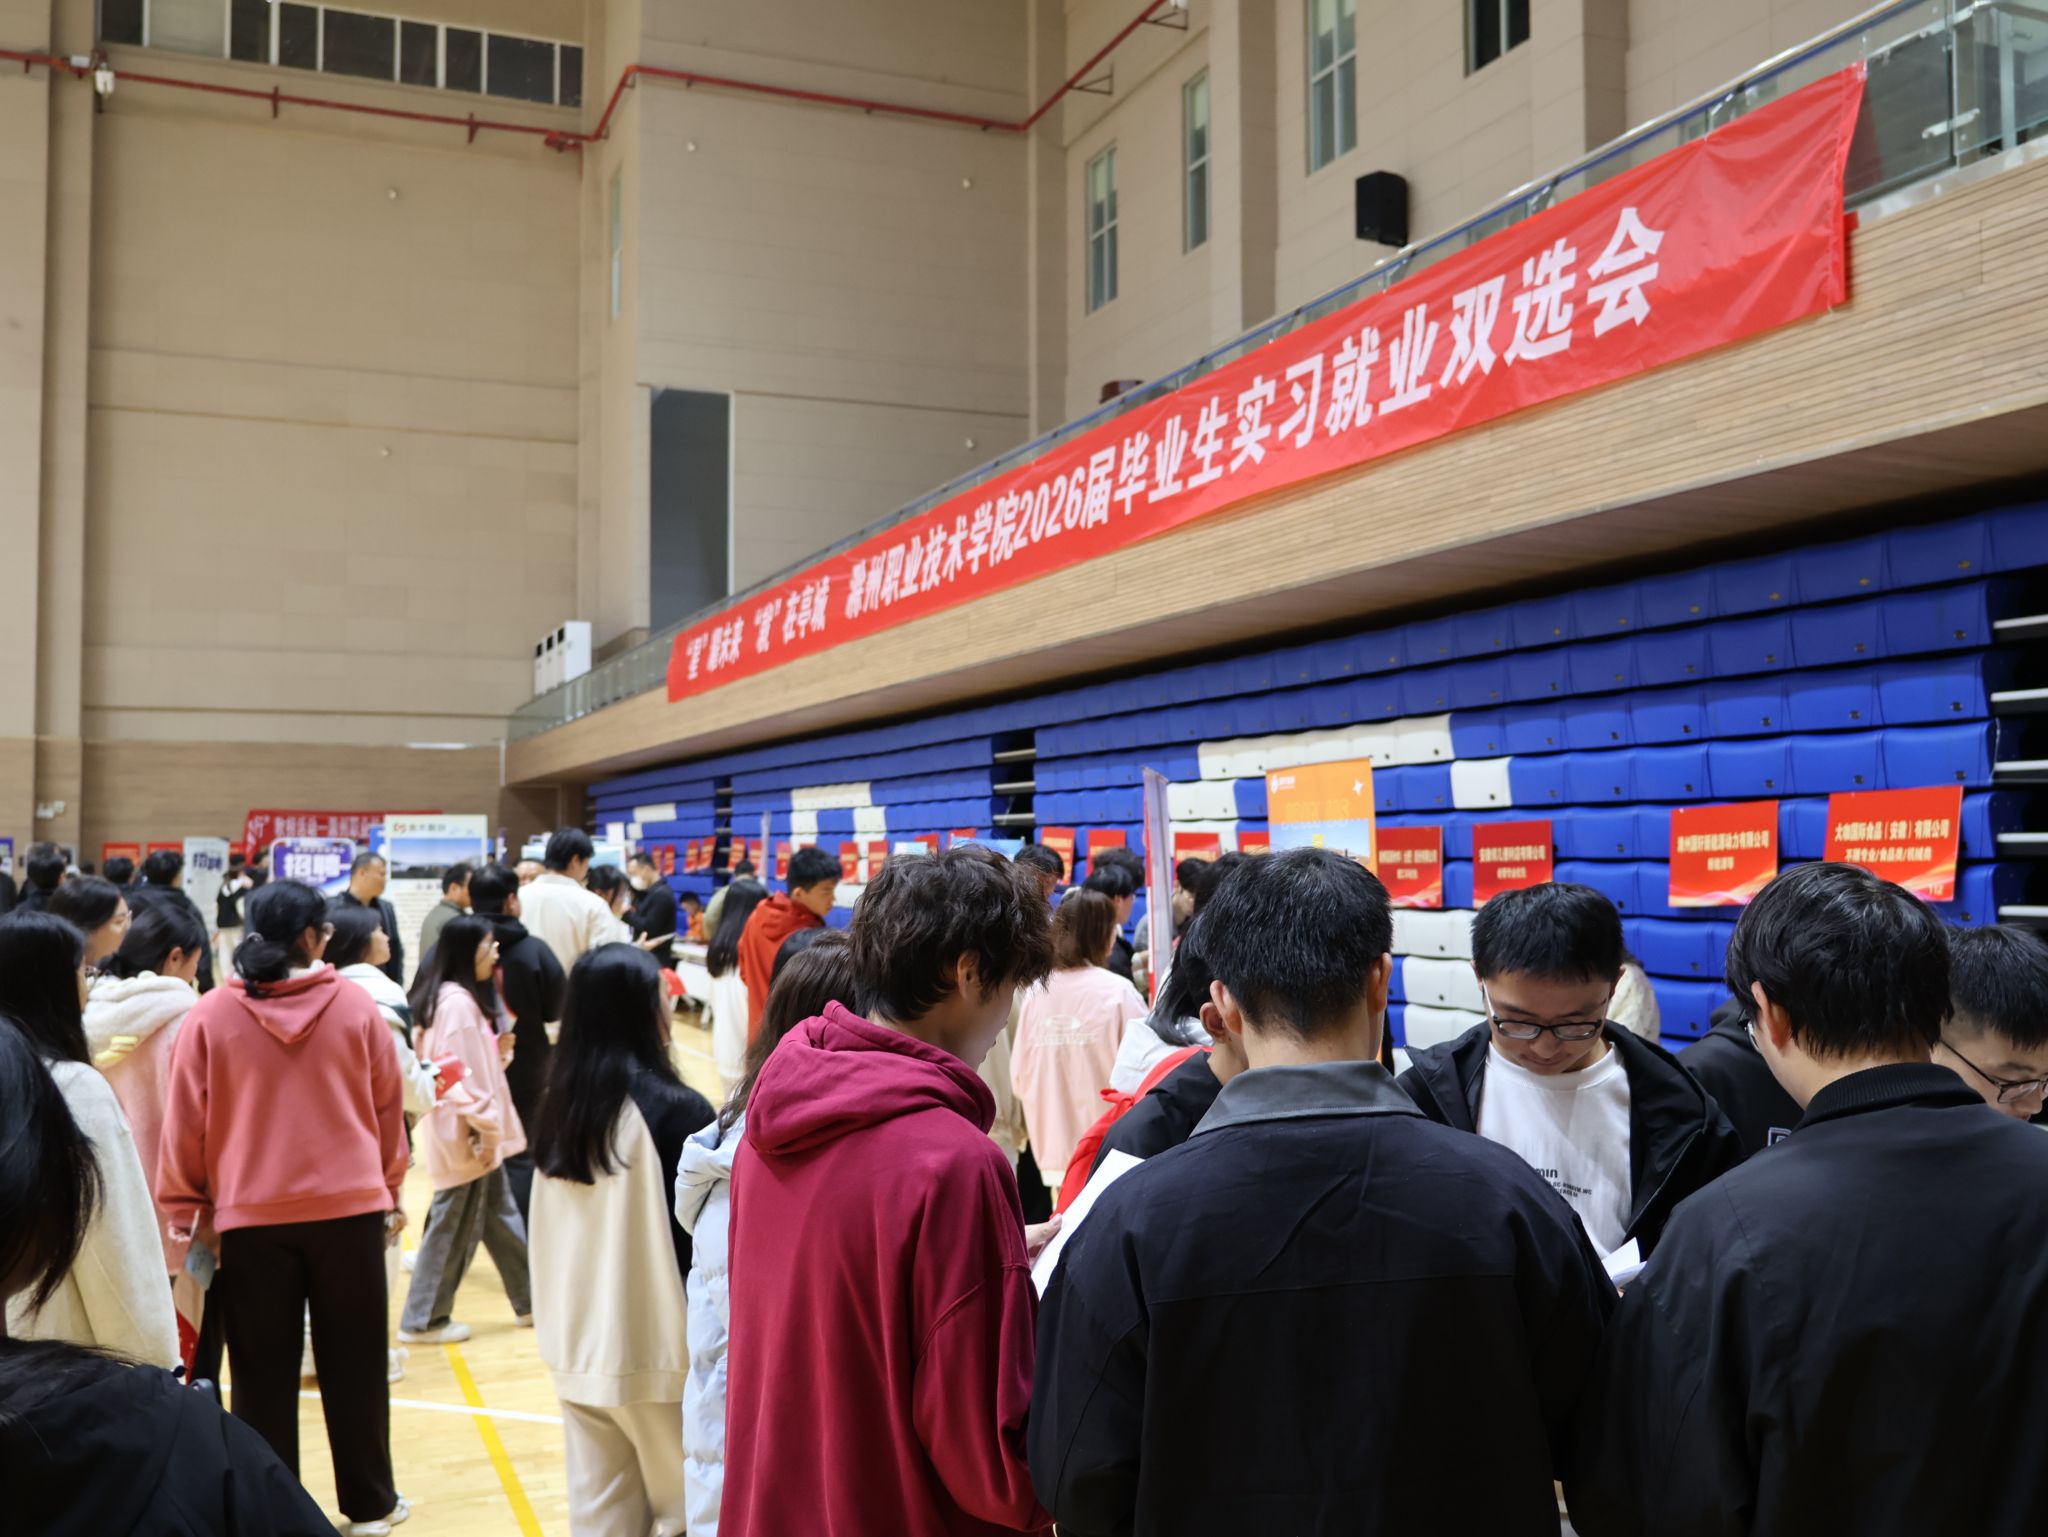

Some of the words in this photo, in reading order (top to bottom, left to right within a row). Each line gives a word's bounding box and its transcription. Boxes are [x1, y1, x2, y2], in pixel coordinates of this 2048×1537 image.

[845, 207, 1664, 619] 滁州职业技术学院2026届毕业生实习就业双选会
